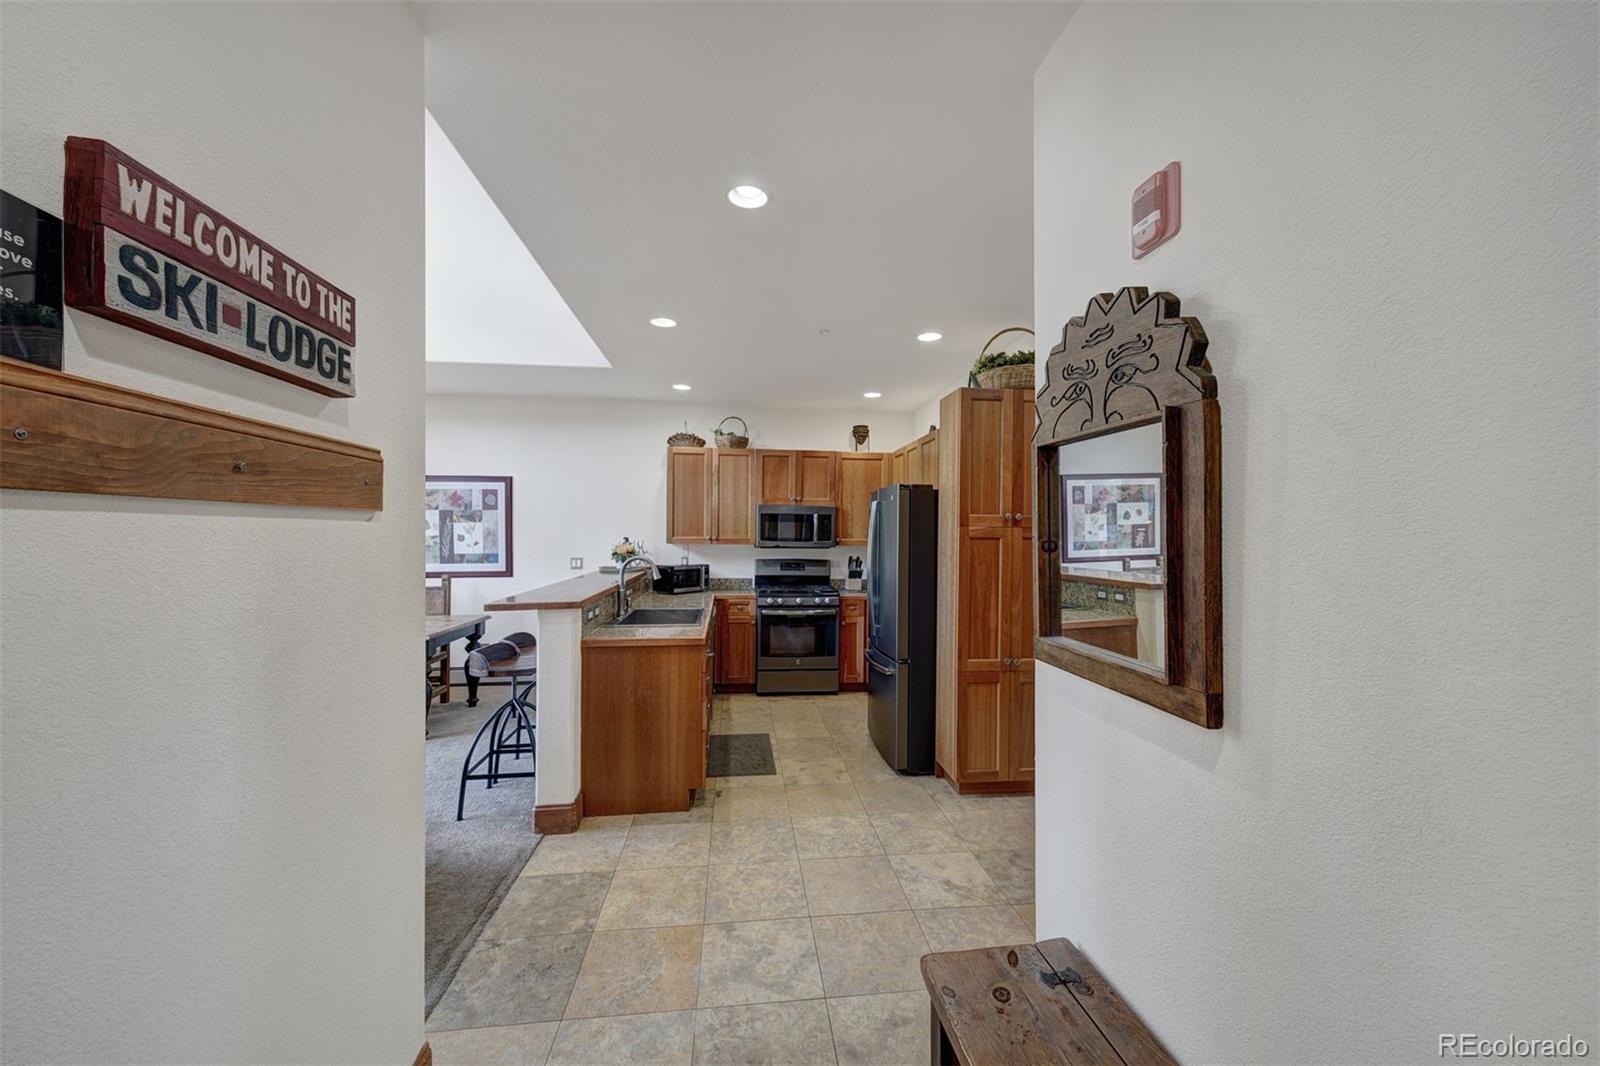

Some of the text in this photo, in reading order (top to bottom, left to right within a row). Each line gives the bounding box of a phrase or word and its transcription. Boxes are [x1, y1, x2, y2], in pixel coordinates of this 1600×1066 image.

[117, 163, 352, 332] WELCOME TO THE
